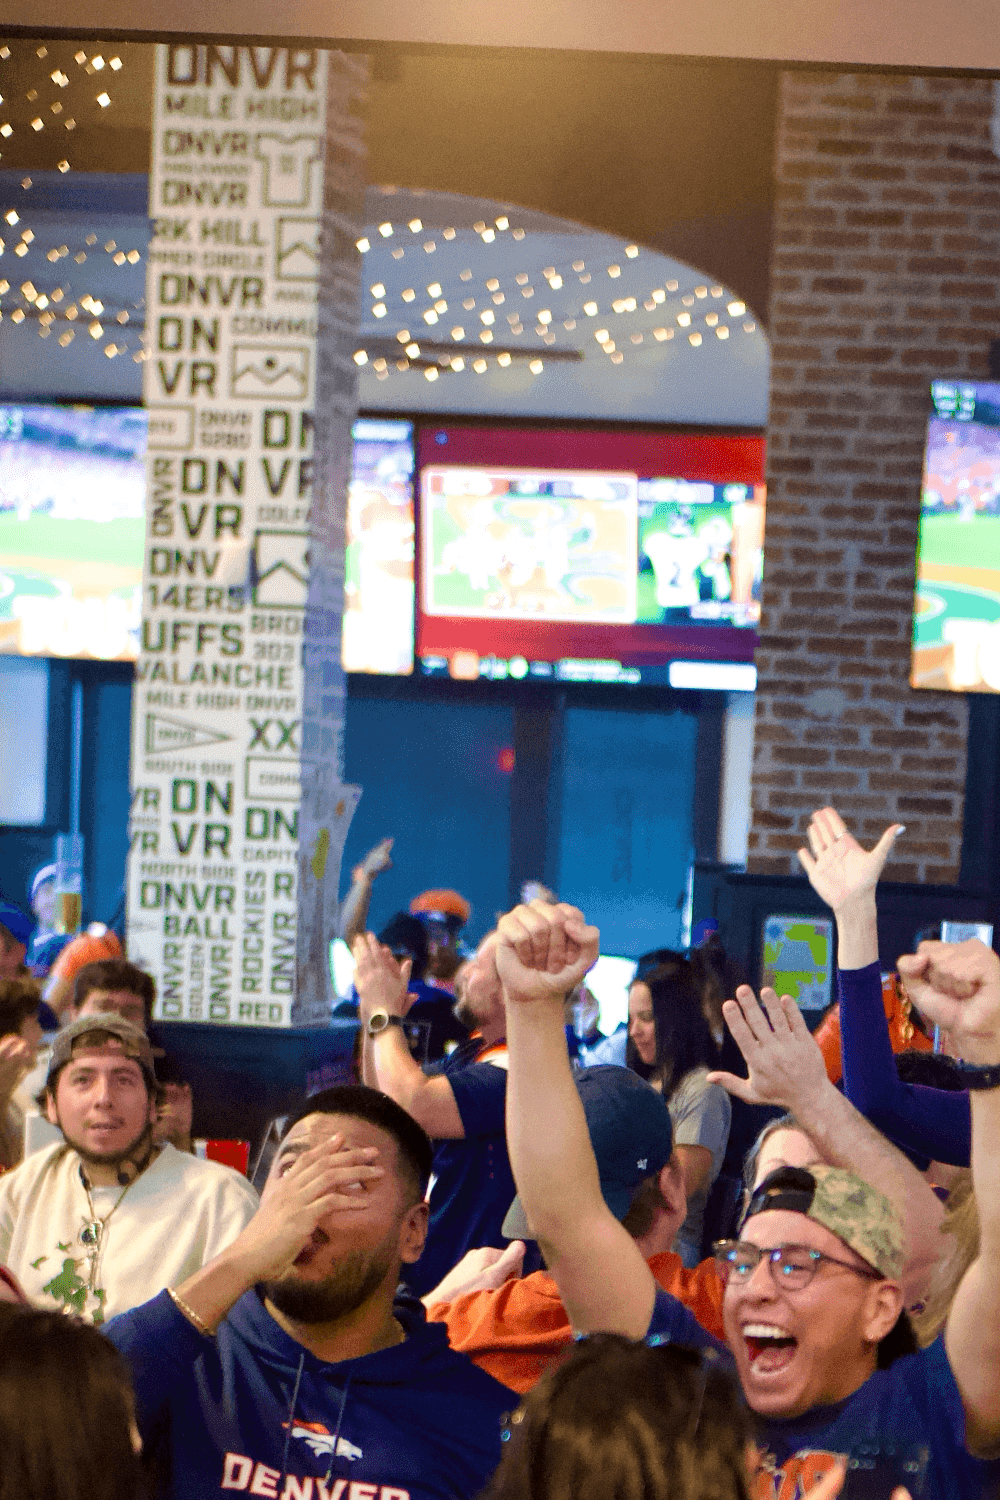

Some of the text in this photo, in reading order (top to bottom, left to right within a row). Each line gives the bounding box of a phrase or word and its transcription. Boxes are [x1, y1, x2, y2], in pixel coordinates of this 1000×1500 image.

[168, 45, 316, 90] DNVR
[163, 130, 248, 156] DNVR
[162, 180, 248, 207] DNVR
[160, 274, 263, 308] DNVR
[151, 549, 220, 577] DNV
[142, 618, 243, 657] UFFS
[140, 881, 236, 915] DNVR
[163, 915, 235, 940] BALL
[241, 870, 267, 994] ROCKIES
[270, 911, 297, 995] DNVR
[162, 942, 184, 1018] DNVR
[209, 945, 232, 1020] DNVR
[238, 1002, 283, 1024] RED
